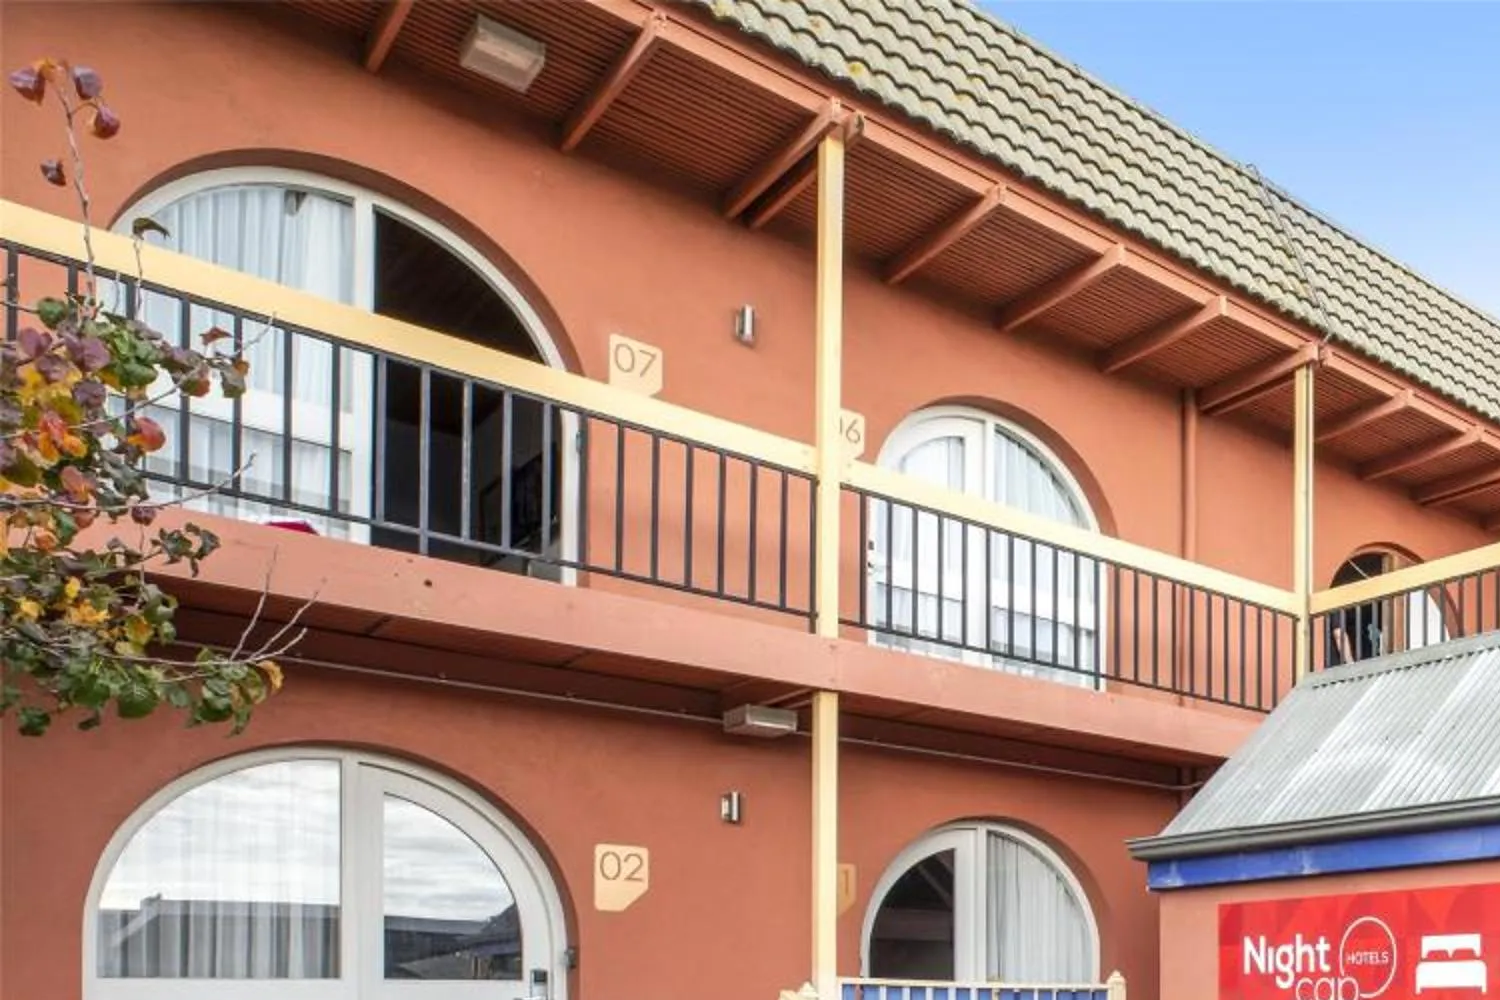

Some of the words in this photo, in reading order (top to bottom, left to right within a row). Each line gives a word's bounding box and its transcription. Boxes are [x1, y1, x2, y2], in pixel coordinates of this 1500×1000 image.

[614, 343, 656, 378] 07
[839, 416, 861, 444] 6
[600, 851, 645, 882] 02
[1243, 934, 1331, 989] Night
[1346, 951, 1389, 965] HOTELS
